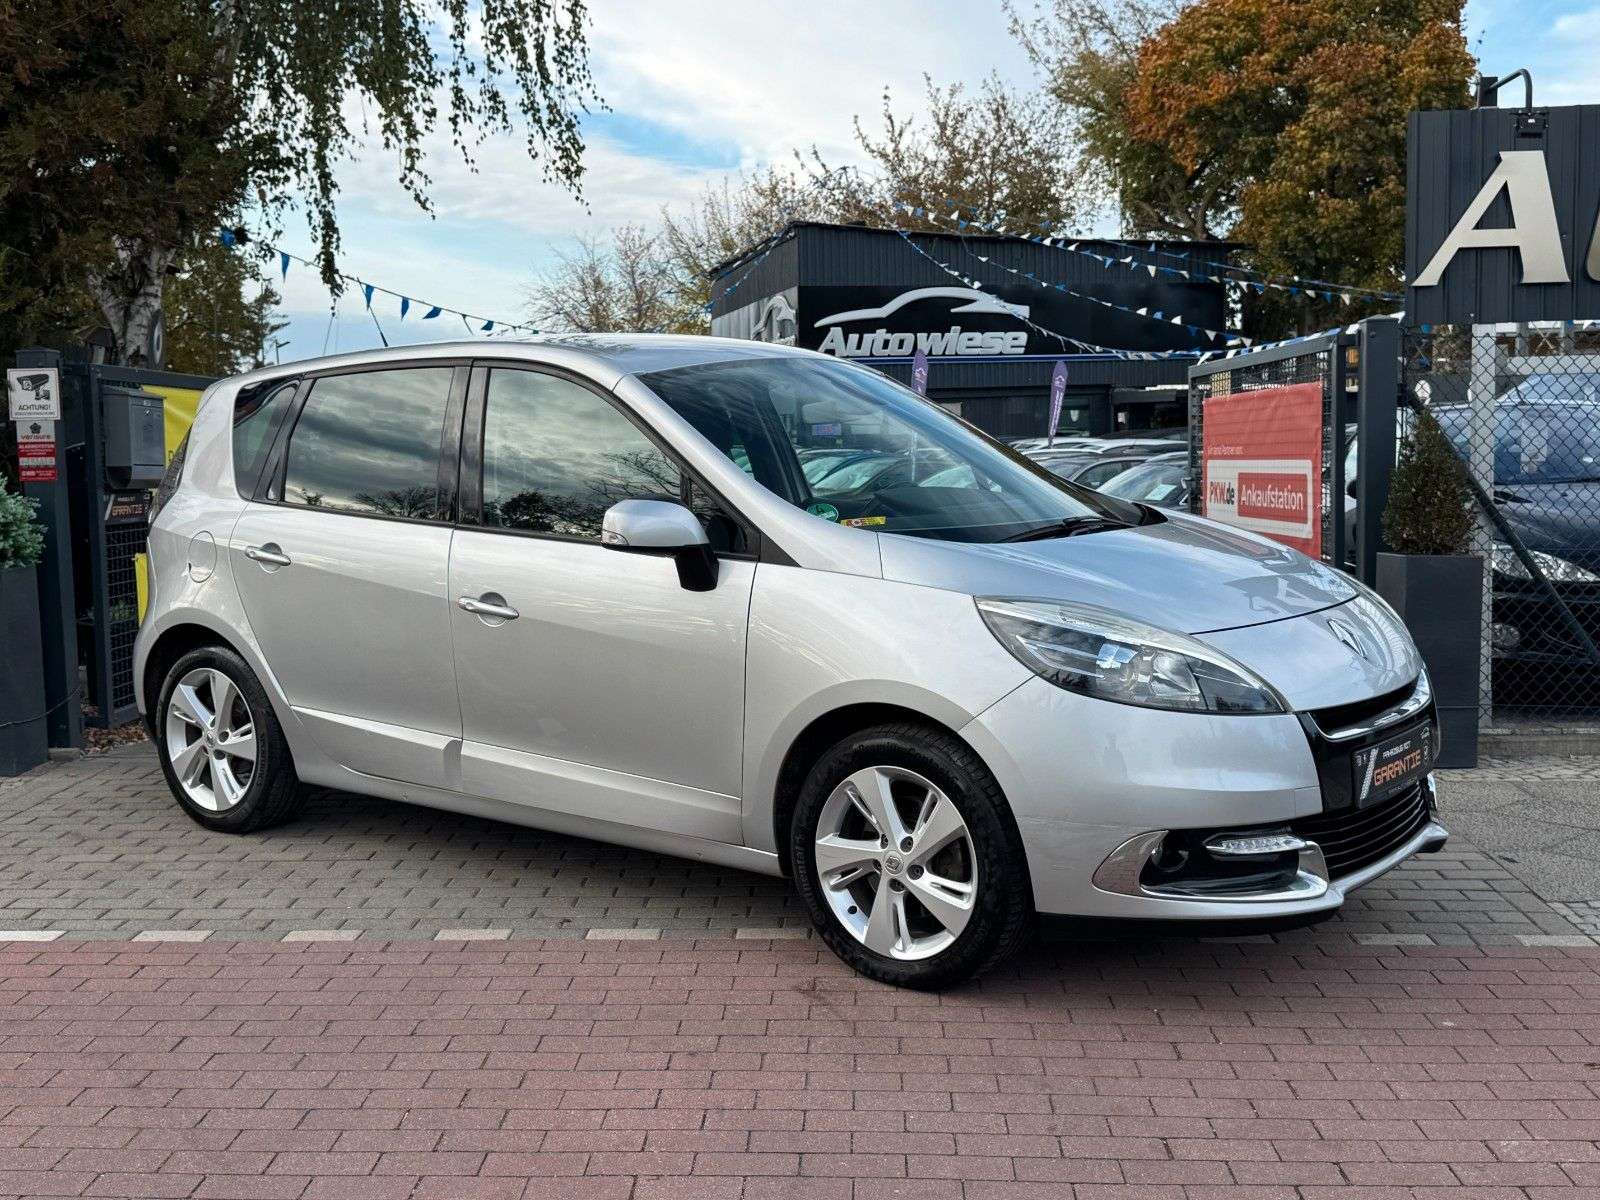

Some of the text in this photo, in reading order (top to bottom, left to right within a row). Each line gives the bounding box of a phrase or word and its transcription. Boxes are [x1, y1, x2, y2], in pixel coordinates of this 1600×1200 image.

[1410, 149, 1600, 287] A
[1240, 483, 1304, 510] Ankaufstation
[1373, 749, 1422, 787] GARANTIE
